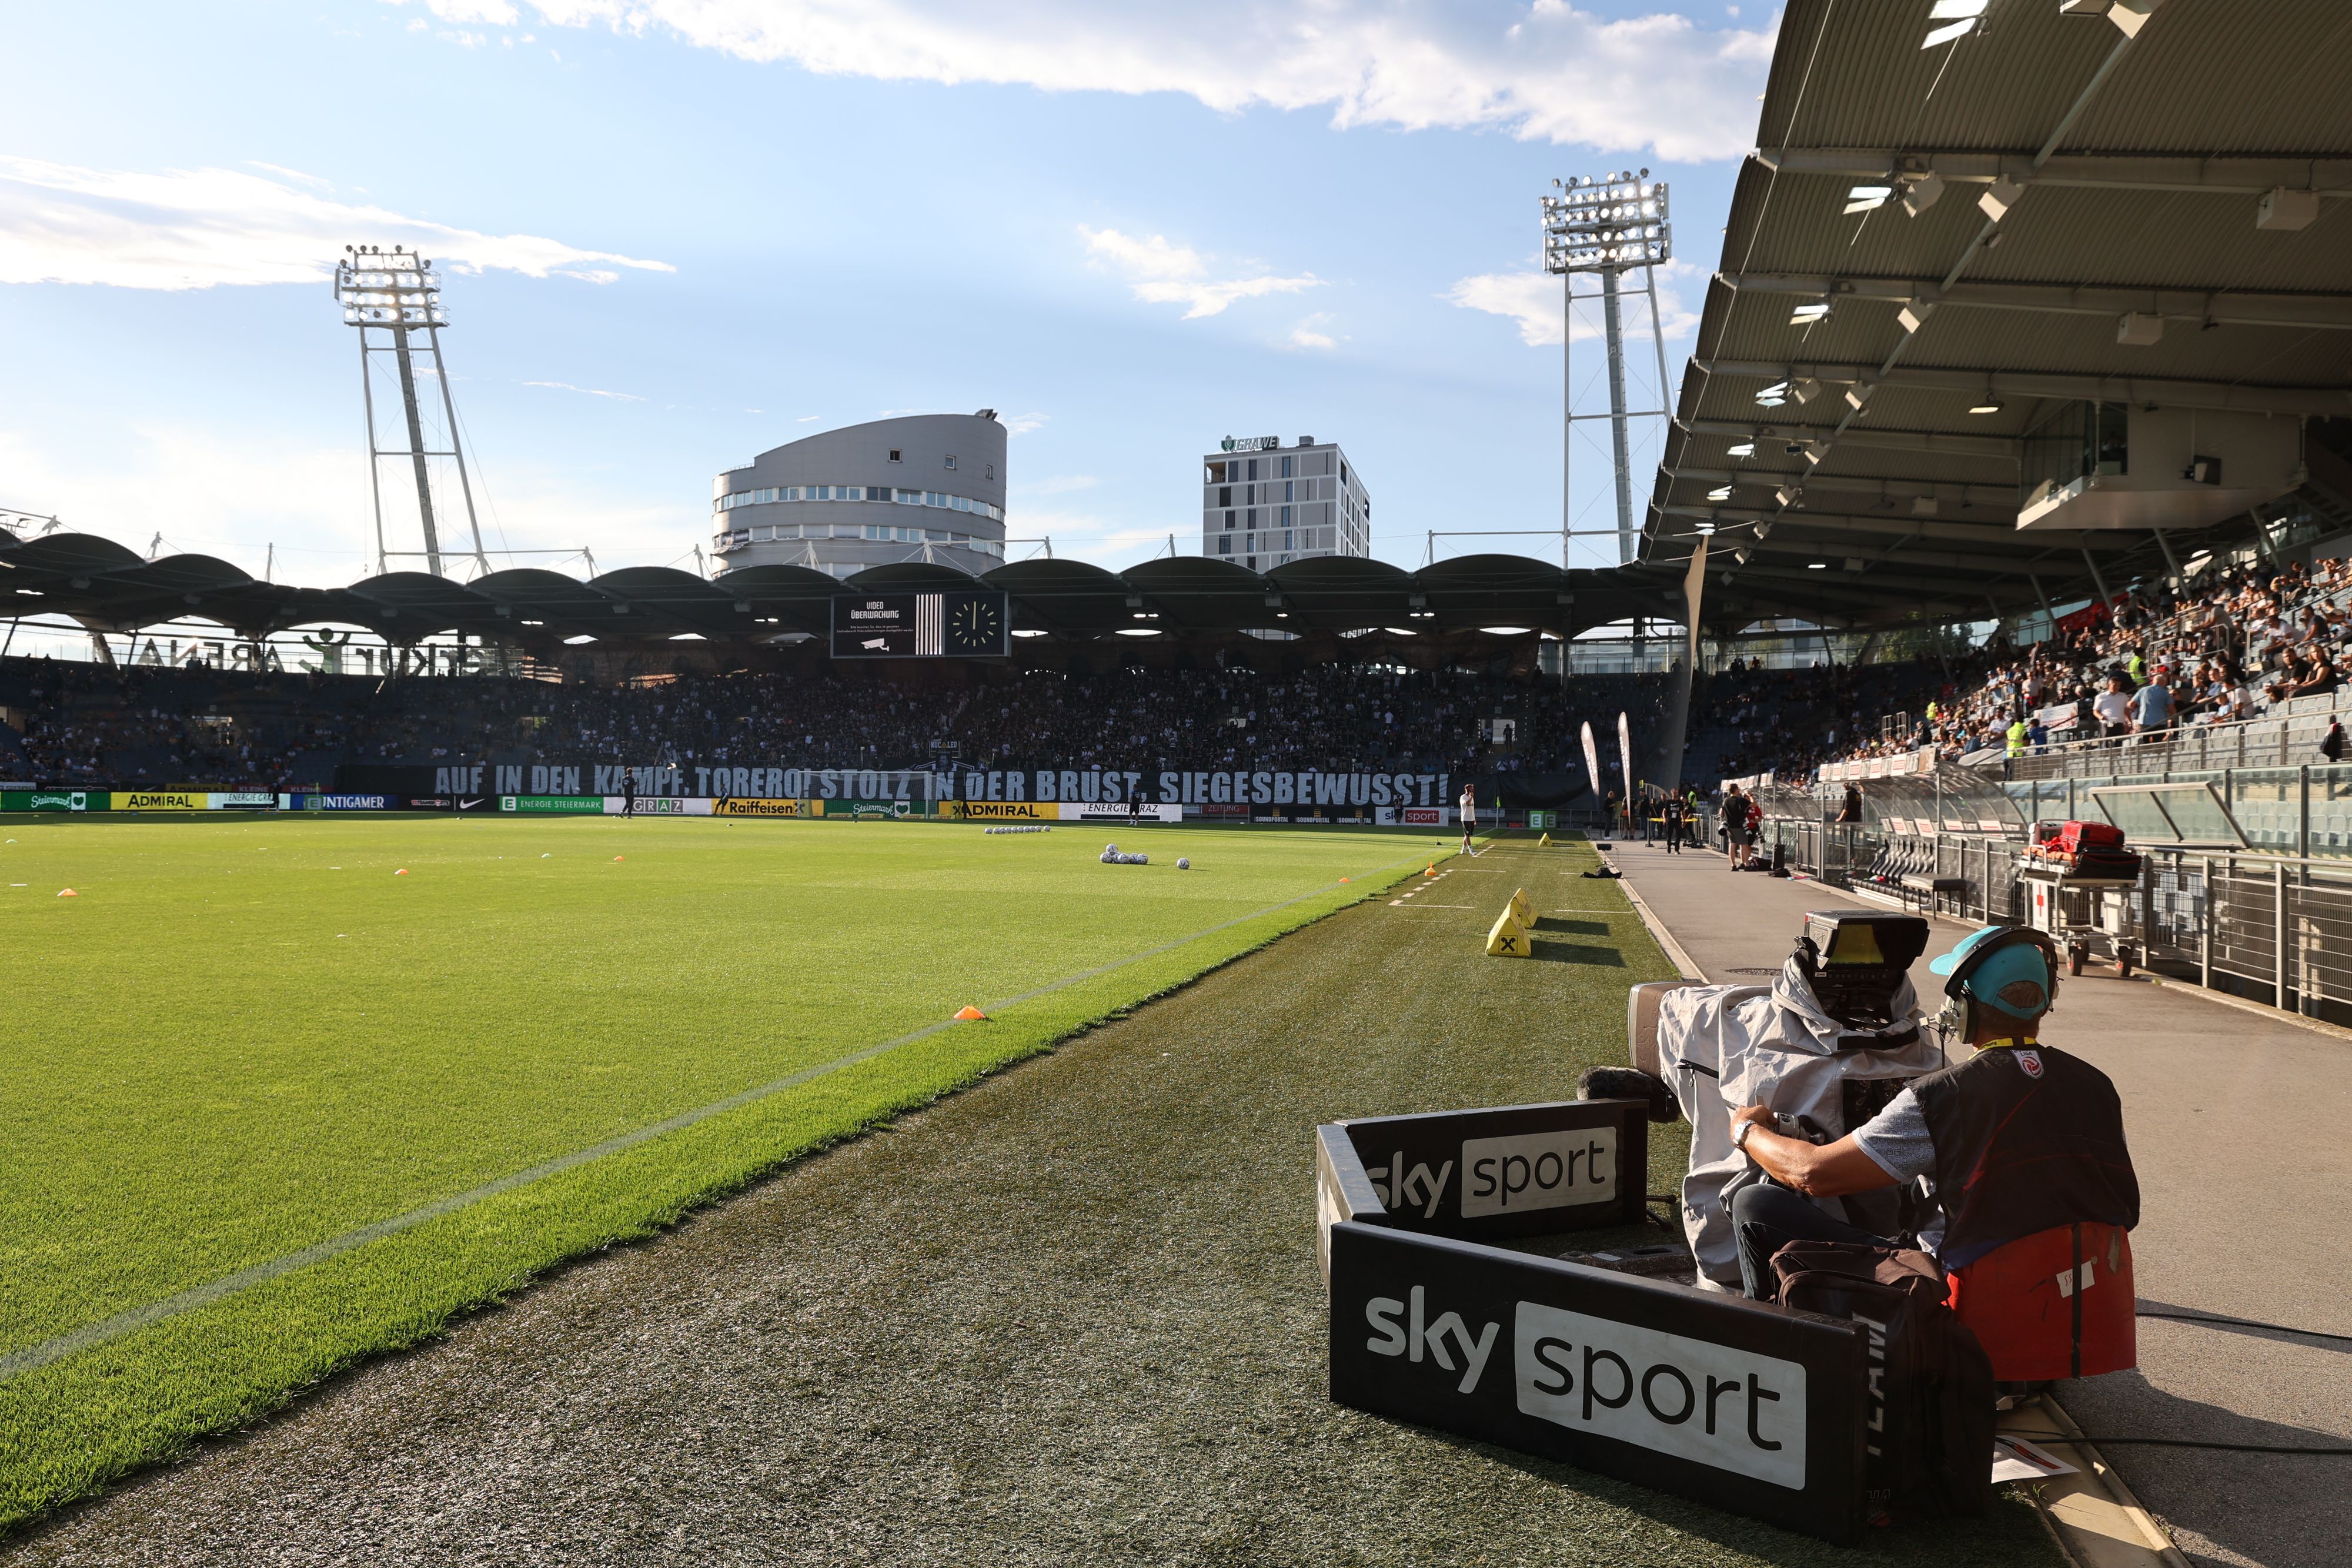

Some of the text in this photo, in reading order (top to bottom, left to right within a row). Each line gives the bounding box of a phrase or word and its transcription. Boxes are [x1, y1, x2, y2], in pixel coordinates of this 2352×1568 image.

[1236, 436, 1277, 450] GRAWE
[866, 601, 884, 610] VIDEO
[851, 610, 899, 619] ÜBERWACHUNG
[435, 767, 483, 794] AUF
[496, 765, 522, 794] IN
[532, 765, 580, 794] DEN
[695, 767, 811, 798] TORERO!
[820, 768, 911, 800] STOLZ
[924, 771, 954, 801] IN
[965, 771, 1025, 801] DER
[1159, 771, 1449, 806] SIEGESBEWUSST!
[31, 795, 71, 808] Steiermark
[128, 794, 193, 808] ADMIRAL
[520, 800, 552, 808] ENERGIE
[554, 800, 601, 809] STEIERMARK
[633, 800, 681, 813] GRAZ
[730, 801, 793, 814] Raiffeisen
[853, 803, 894, 815] Steiermark
[961, 803, 1040, 818] ADMIRAL
[1088, 804, 1158, 813] ENERGIE RAZ
[1208, 804, 1240, 813] ZEITUNG
[1407, 811, 1437, 821] sport
[1367, 1141, 1606, 1219] sky sport
[1366, 1285, 1782, 1452] sky sport
